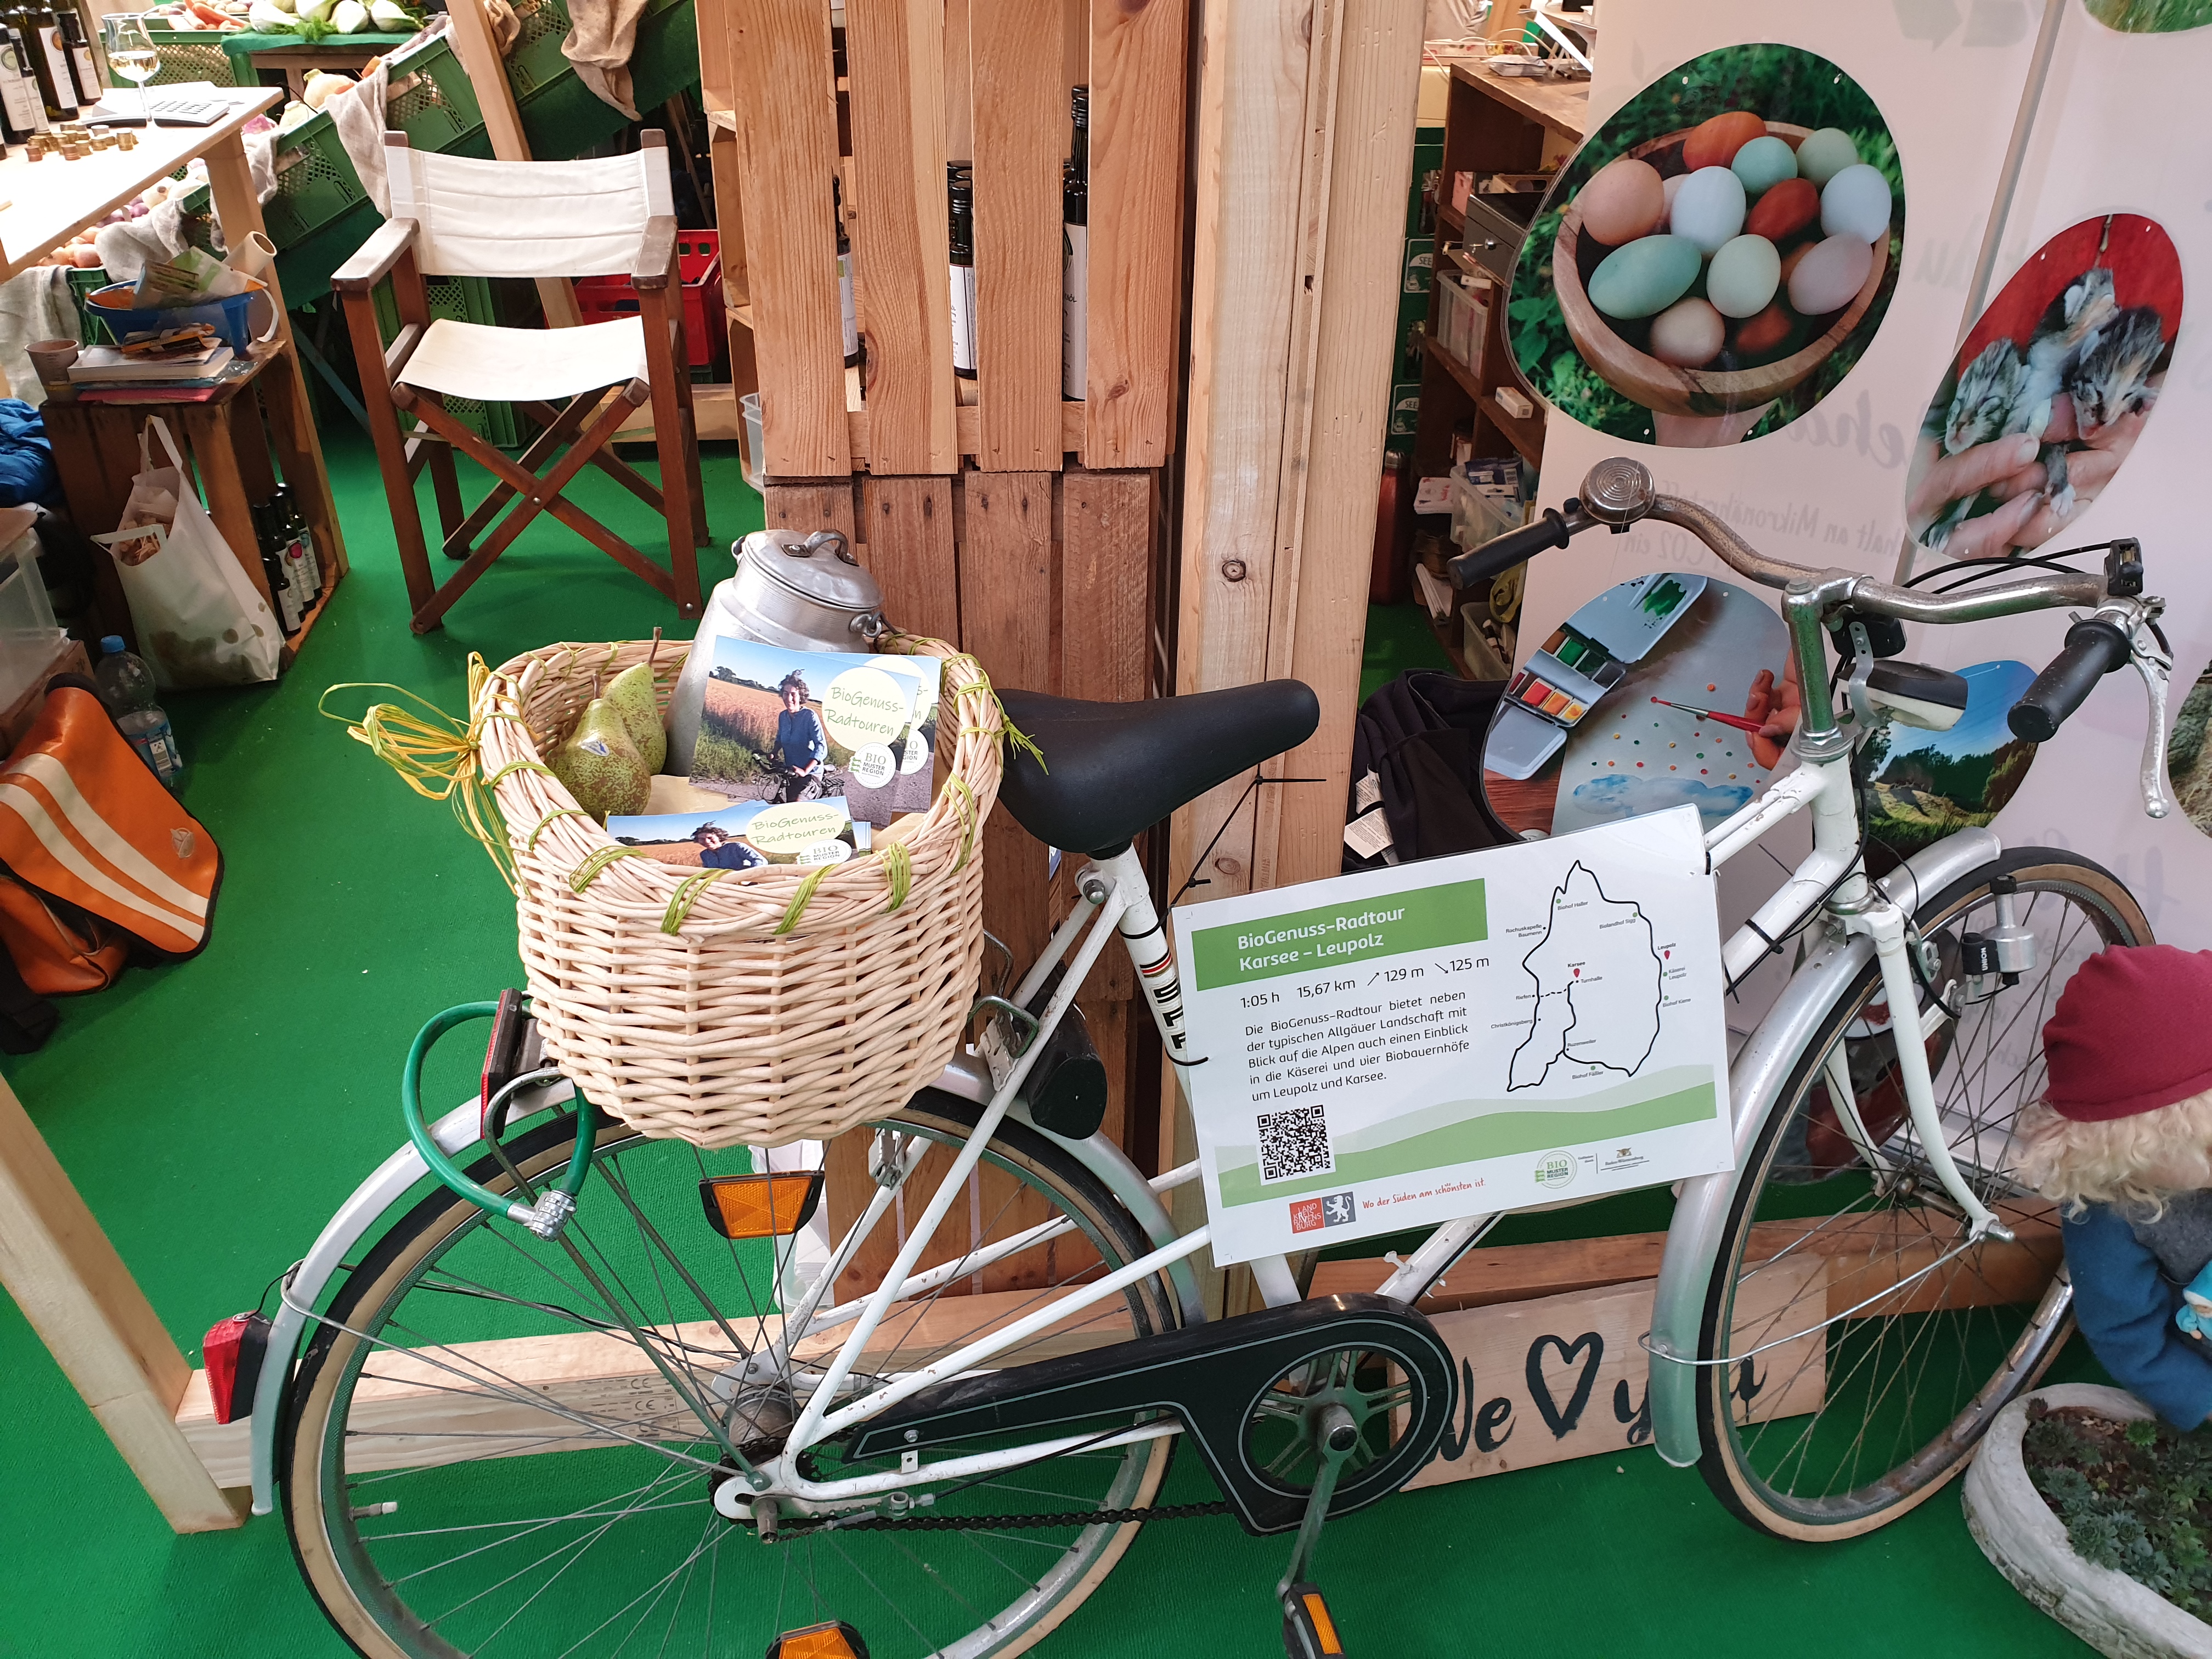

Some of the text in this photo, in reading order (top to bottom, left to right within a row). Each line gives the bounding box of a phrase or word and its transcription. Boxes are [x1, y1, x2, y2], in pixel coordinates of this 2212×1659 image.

[831, 687, 904, 713] BioGenuss-
[824, 709, 894, 736] Radtouren
[865, 752, 887, 765] BIO
[862, 767, 884, 776] REGION
[863, 762, 885, 771] MUSTER
[751, 812, 839, 831] BioGenuss-
[751, 827, 836, 845] Radtouren
[813, 845, 838, 854] BIO
[1573, 900, 1589, 909] Haller
[1505, 924, 1543, 934] Rochuskapelle
[1599, 918, 1637, 930] Biolandhof Sigg
[1239, 951, 1300, 972] Karsee
[1316, 933, 1385, 958] Leupolz
[1657, 943, 1677, 951] Leupolz
[1980, 947, 1989, 971] UNION
[1668, 966, 1686, 974] Käserei
[1668, 972, 1687, 980] Leupolz
[1240, 957, 1490, 1009] 1:05 h 15,67 km 129 m 125 m
[1580, 975, 1603, 984] Turnhalle
[1245, 1025, 1264, 1036] Die
[1389, 997, 1423, 1011] bietet
[1429, 991, 1466, 1006] neben
[1246, 1007, 1468, 1052] der typischen Allgäuer Landschaft mit
[1490, 1018, 1533, 1030] Christkönigsberg
[1248, 1023, 1469, 1069] Blick auf die Alpen auch einen Einblick
[1567, 1039, 1597, 1048] Ruzenweiler
[1249, 1040, 1470, 1086] in die Käserei und vier Biobauernhöfe
[1251, 1071, 1387, 1102] um Leupolz und Karsee.
[1546, 1159, 1568, 1170] BIO
[1362, 1200, 1375, 1209] Wo
[1376, 1197, 1391, 1207] der
[1392, 1193, 1417, 1204] Süden
[1435, 1182, 1472, 1196] schönsten
